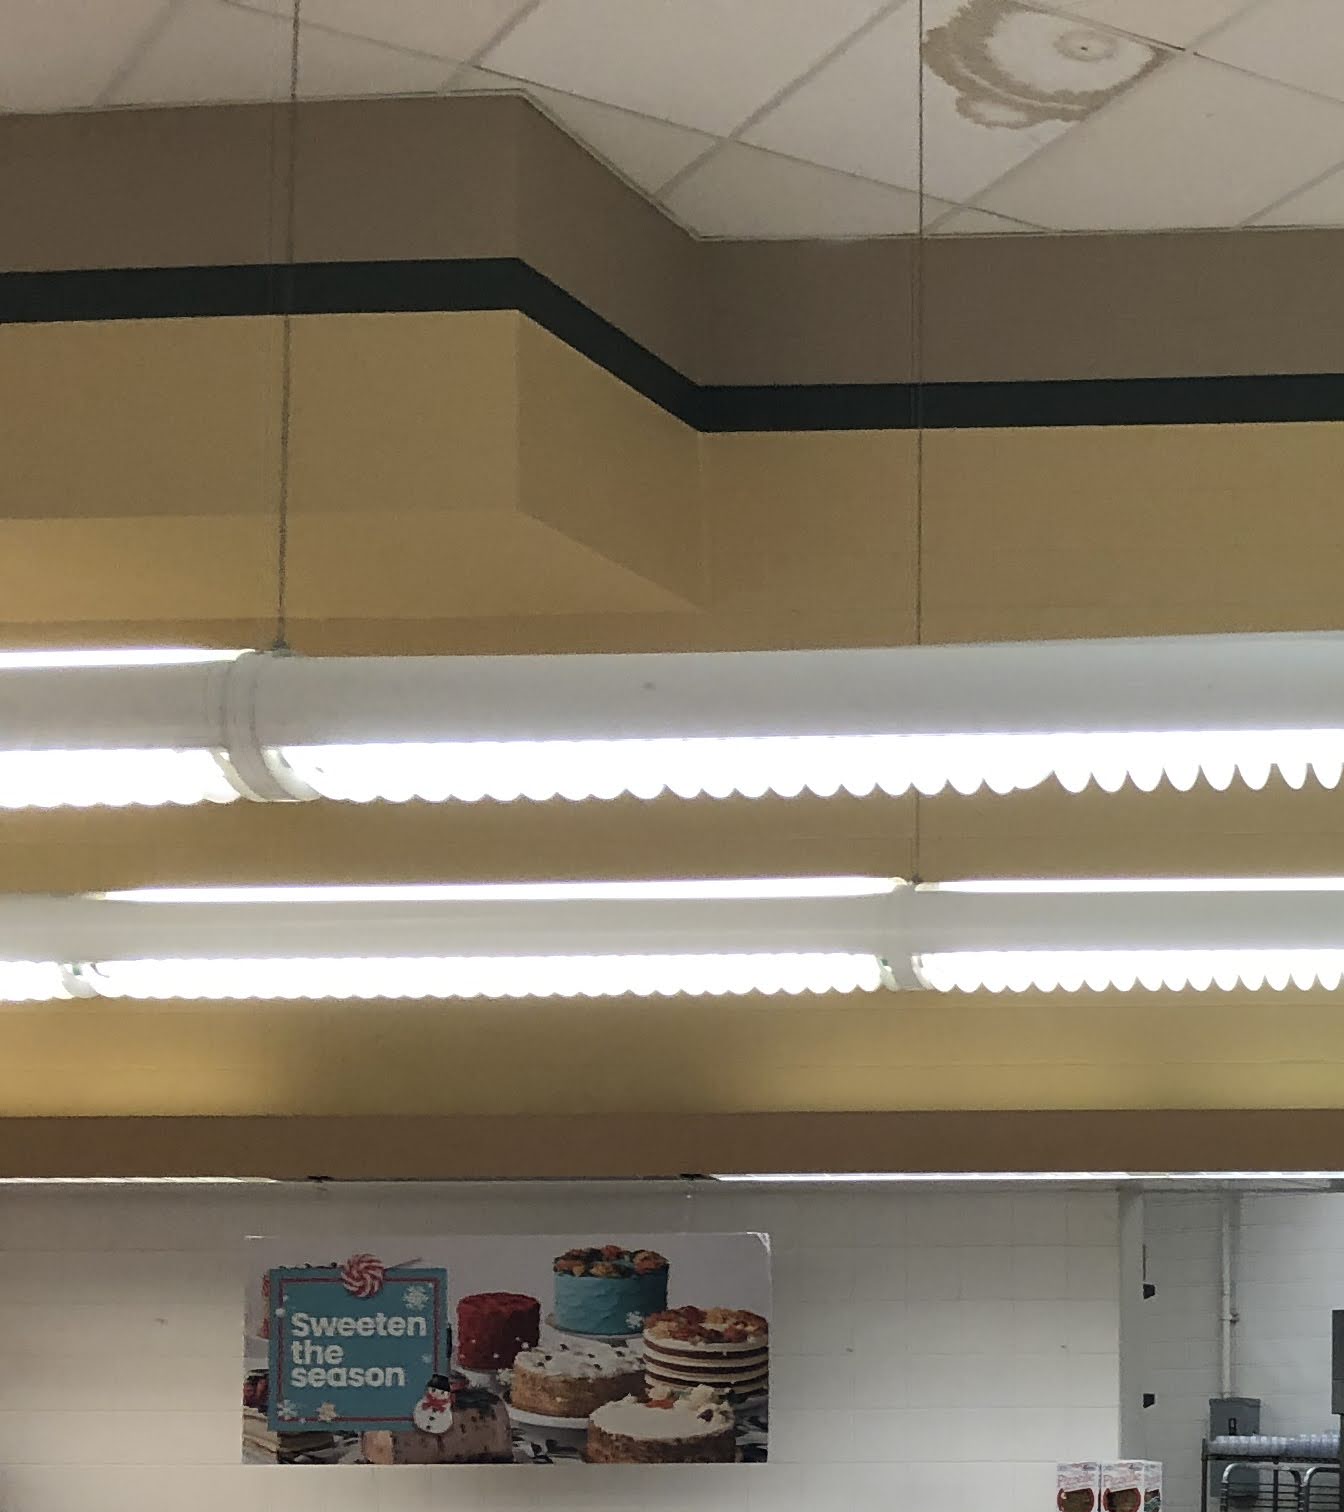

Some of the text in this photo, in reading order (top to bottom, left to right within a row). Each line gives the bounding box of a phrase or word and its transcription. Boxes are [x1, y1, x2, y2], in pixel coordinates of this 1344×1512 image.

[291, 1312, 427, 1337] Sweeten
[291, 1339, 344, 1365] the
[291, 1366, 405, 1387] season
